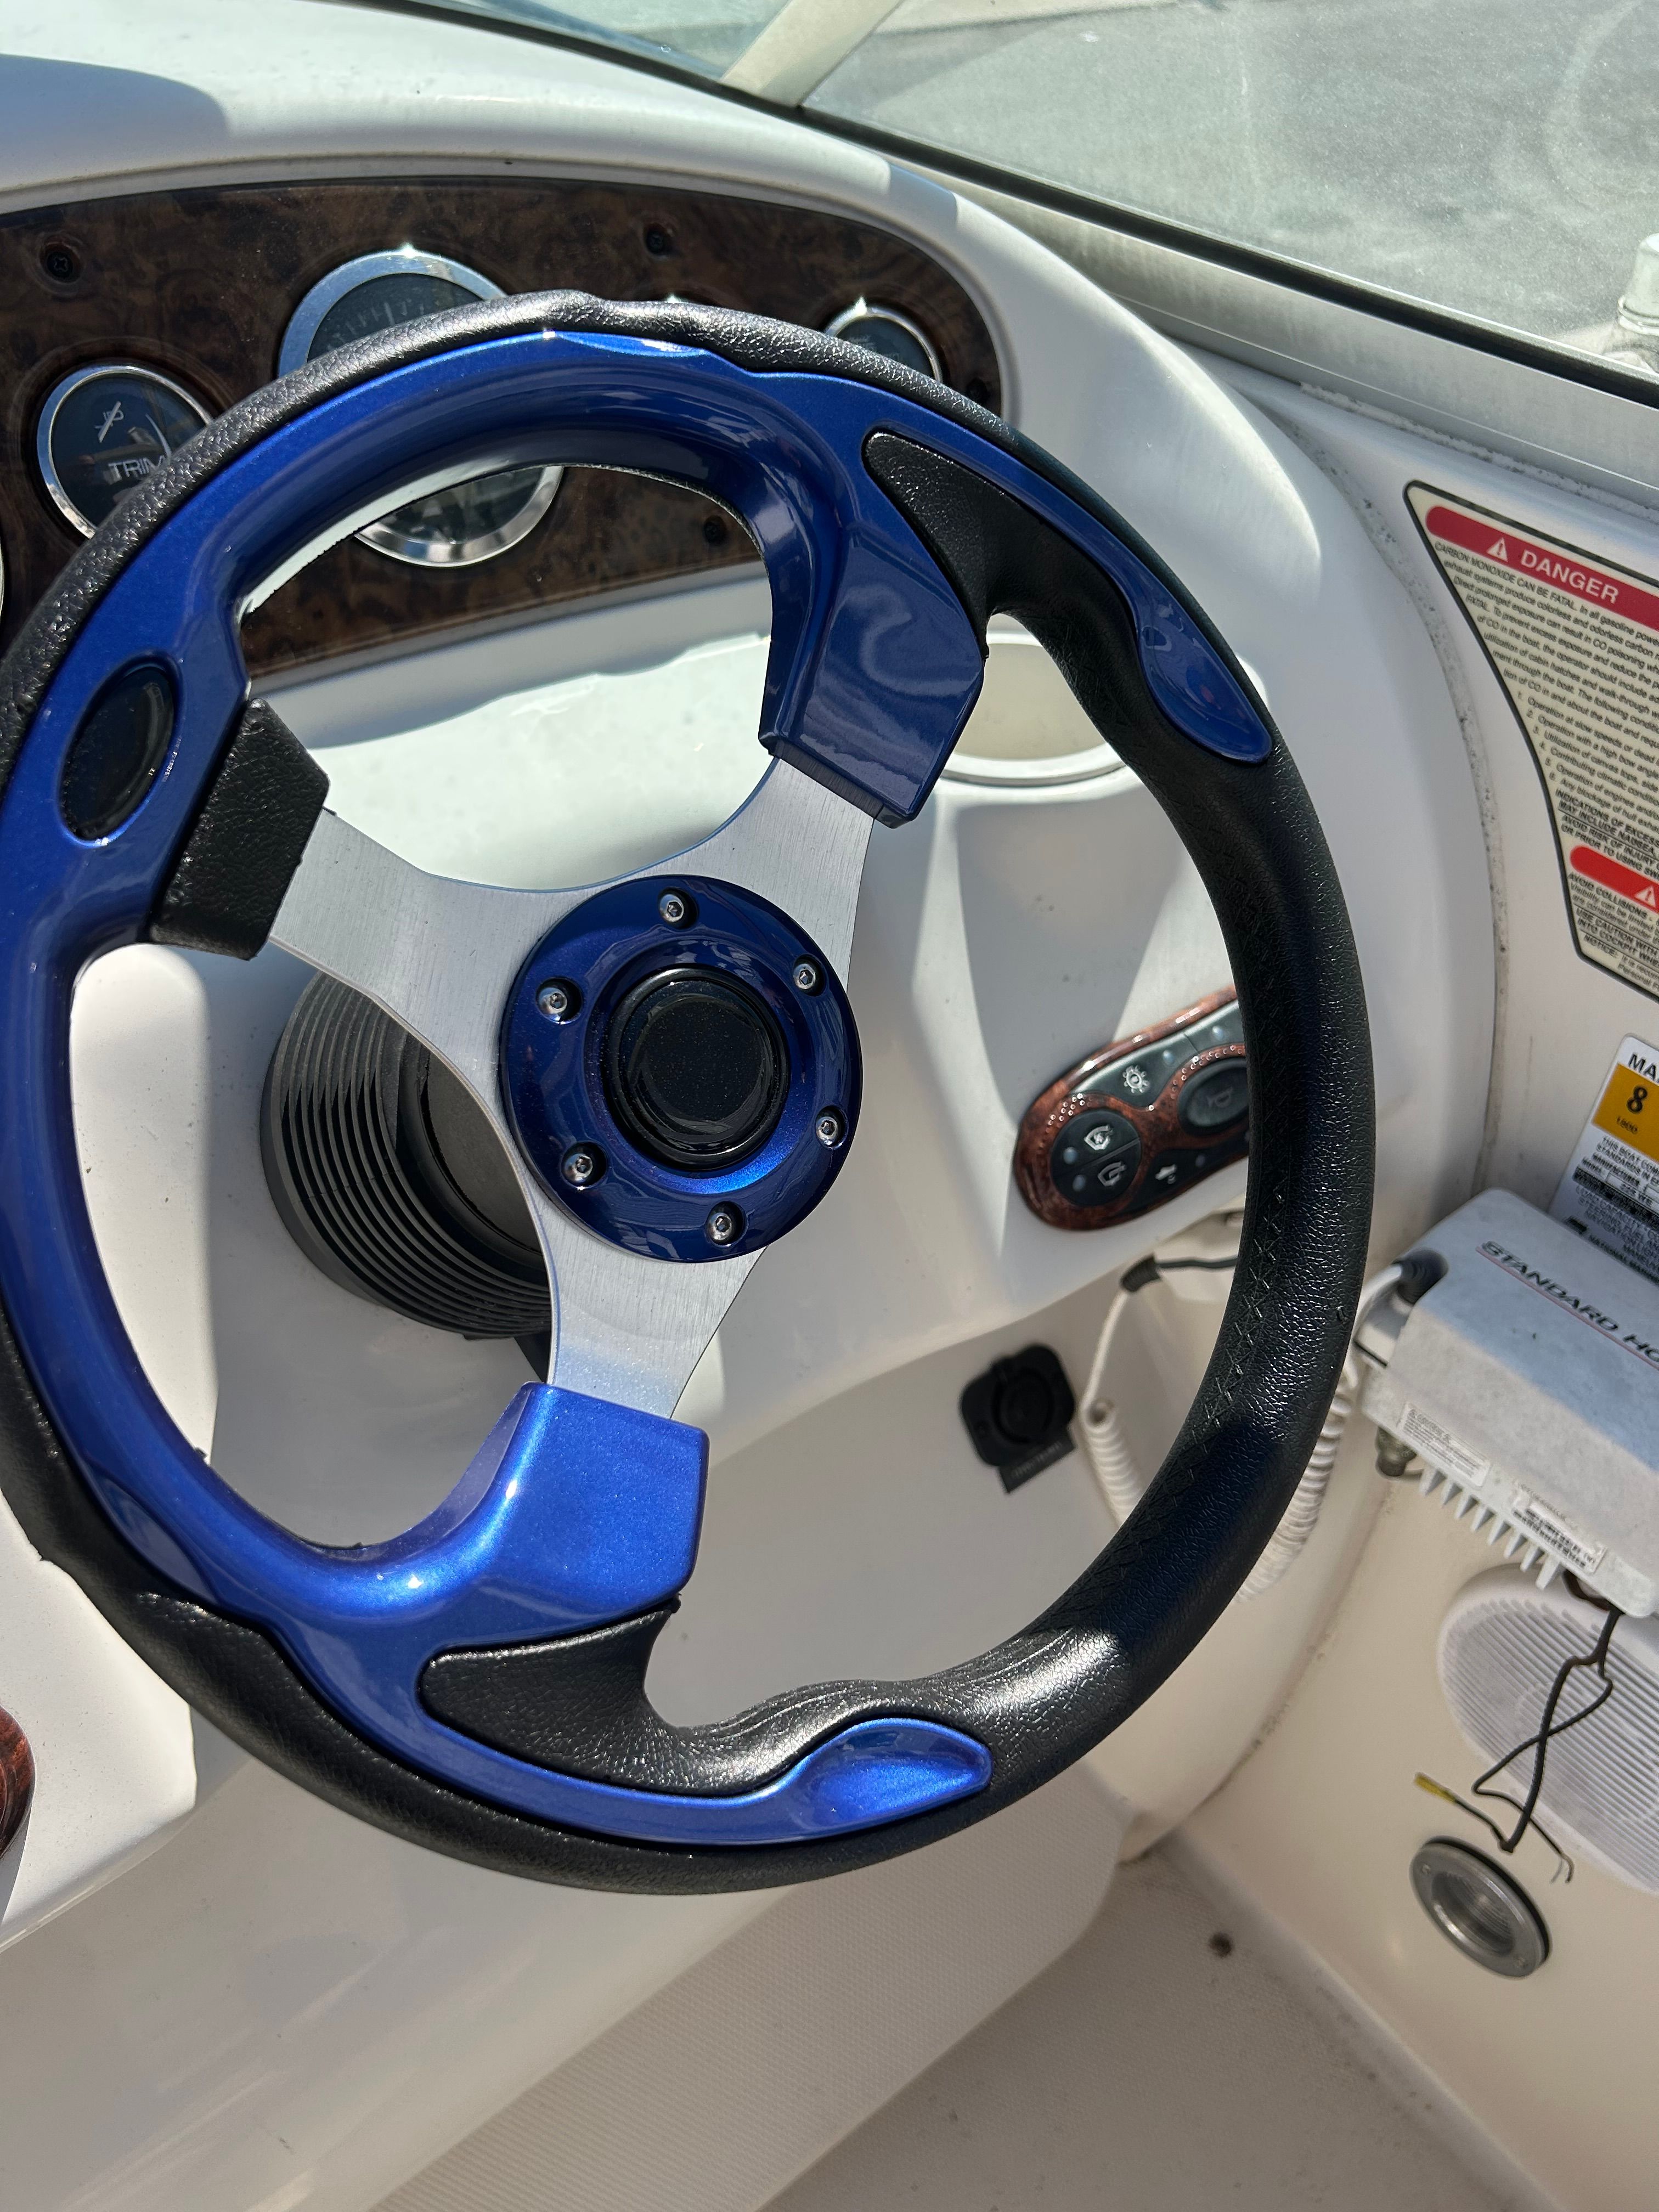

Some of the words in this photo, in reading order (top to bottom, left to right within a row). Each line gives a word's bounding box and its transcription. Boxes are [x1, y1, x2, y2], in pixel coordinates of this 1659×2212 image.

[1435, 541, 1470, 563] CARBON
[1471, 557, 1516, 584] MONOXIDE
[1517, 577, 1536, 592] CAN
[1600, 616, 1634, 636] gasoline
[1520, 549, 1620, 604] DANGER
[1443, 560, 1472, 577] exhaust
[1473, 573, 1503, 591] systems
[1504, 586, 1536, 605] produce
[1537, 601, 1571, 621] colorless
[1572, 617, 1589, 629] and
[1590, 624, 1623, 645] odorless
[1625, 640, 1654, 658] carbon
[1453, 575, 1474, 591] Direct
[1474, 587, 1511, 608] prolonged
[1511, 603, 1545, 623] exposure
[1562, 627, 1583, 640] result
[1606, 646, 1644, 670] poisoning
[1502, 613, 1530, 629] prevent
[1531, 625, 1556, 642] excess
[1558, 637, 1592, 658] exposure
[1593, 653, 1610, 666] and
[1610, 662, 1637, 678] reduce
[1483, 633, 1519, 653] utilization
[1528, 653, 1549, 667] cabin
[1550, 662, 1581, 682] hatches
[1582, 678, 1598, 690] and
[1599, 686, 1649, 714] walk-through
[1493, 651, 1513, 665] ment
[1513, 659, 1541, 678] through
[1594, 697, 1629, 721] following
[1556, 652, 1589, 671] operator
[1590, 667, 1617, 684] should
[1618, 679, 1647, 698] include
[1527, 680, 1542, 693] CO
[1550, 692, 1566, 704] and
[1566, 700, 1589, 715] about
[1604, 716, 1622, 731] boat
[1623, 726, 1640, 740] and
[1527, 696, 1564, 720] Operation
[1574, 721, 1592, 733] slow
[1593, 730, 1622, 748] speeds
[1634, 746, 1656, 764] dead
[1538, 714, 1574, 738] Operation
[1576, 735, 1592, 747] with
[1600, 744, 1617, 759] high
[1618, 753, 1635, 768] bow
[1544, 731, 1581, 755] Utilization
[1590, 755, 1619, 774] canvas
[1641, 780, 1658, 793] side
[1550, 747, 1595, 777] Contributing
[1596, 771, 1627, 791] climatic
[1556, 763, 1593, 788] Operation
[1604, 788, 1635, 809] engines
[1555, 789, 1610, 822] INDICATIONS
[1559, 800, 1579, 816] MAY
[1579, 810, 1618, 836] INCLUDE
[1560, 777, 1576, 794] Any
[1577, 786, 1611, 809] blockage
[1622, 808, 1637, 822] hull
[1562, 814, 1589, 833] AVOID
[1589, 827, 1609, 844] RISK
[1623, 844, 1655, 867] INJURY
[1575, 831, 1602, 851] PRIOR
[1616, 851, 1643, 872] USING
[1569, 872, 1594, 892] AVOID
[1596, 885, 1647, 920] COLLISIONS
[1571, 882, 1601, 907] Visibility
[1601, 900, 1616, 912] can
[1628, 912, 1655, 933] limited
[1586, 902, 1628, 929] considered
[1629, 924, 1652, 941] under
[1576, 907, 1594, 923] USE
[1595, 917, 1635, 945] CAUTION
[1635, 939, 1658, 958] WITH
[1578, 918, 1599, 935] INTO
[1599, 929, 1639, 957] COCKPIT
[1628, 1052, 1659, 1083] MA
[1627, 1086, 1647, 1114] 8
[1602, 1135, 1620, 1152] THIS
[1482, 1241, 1618, 1331] STANDARD
